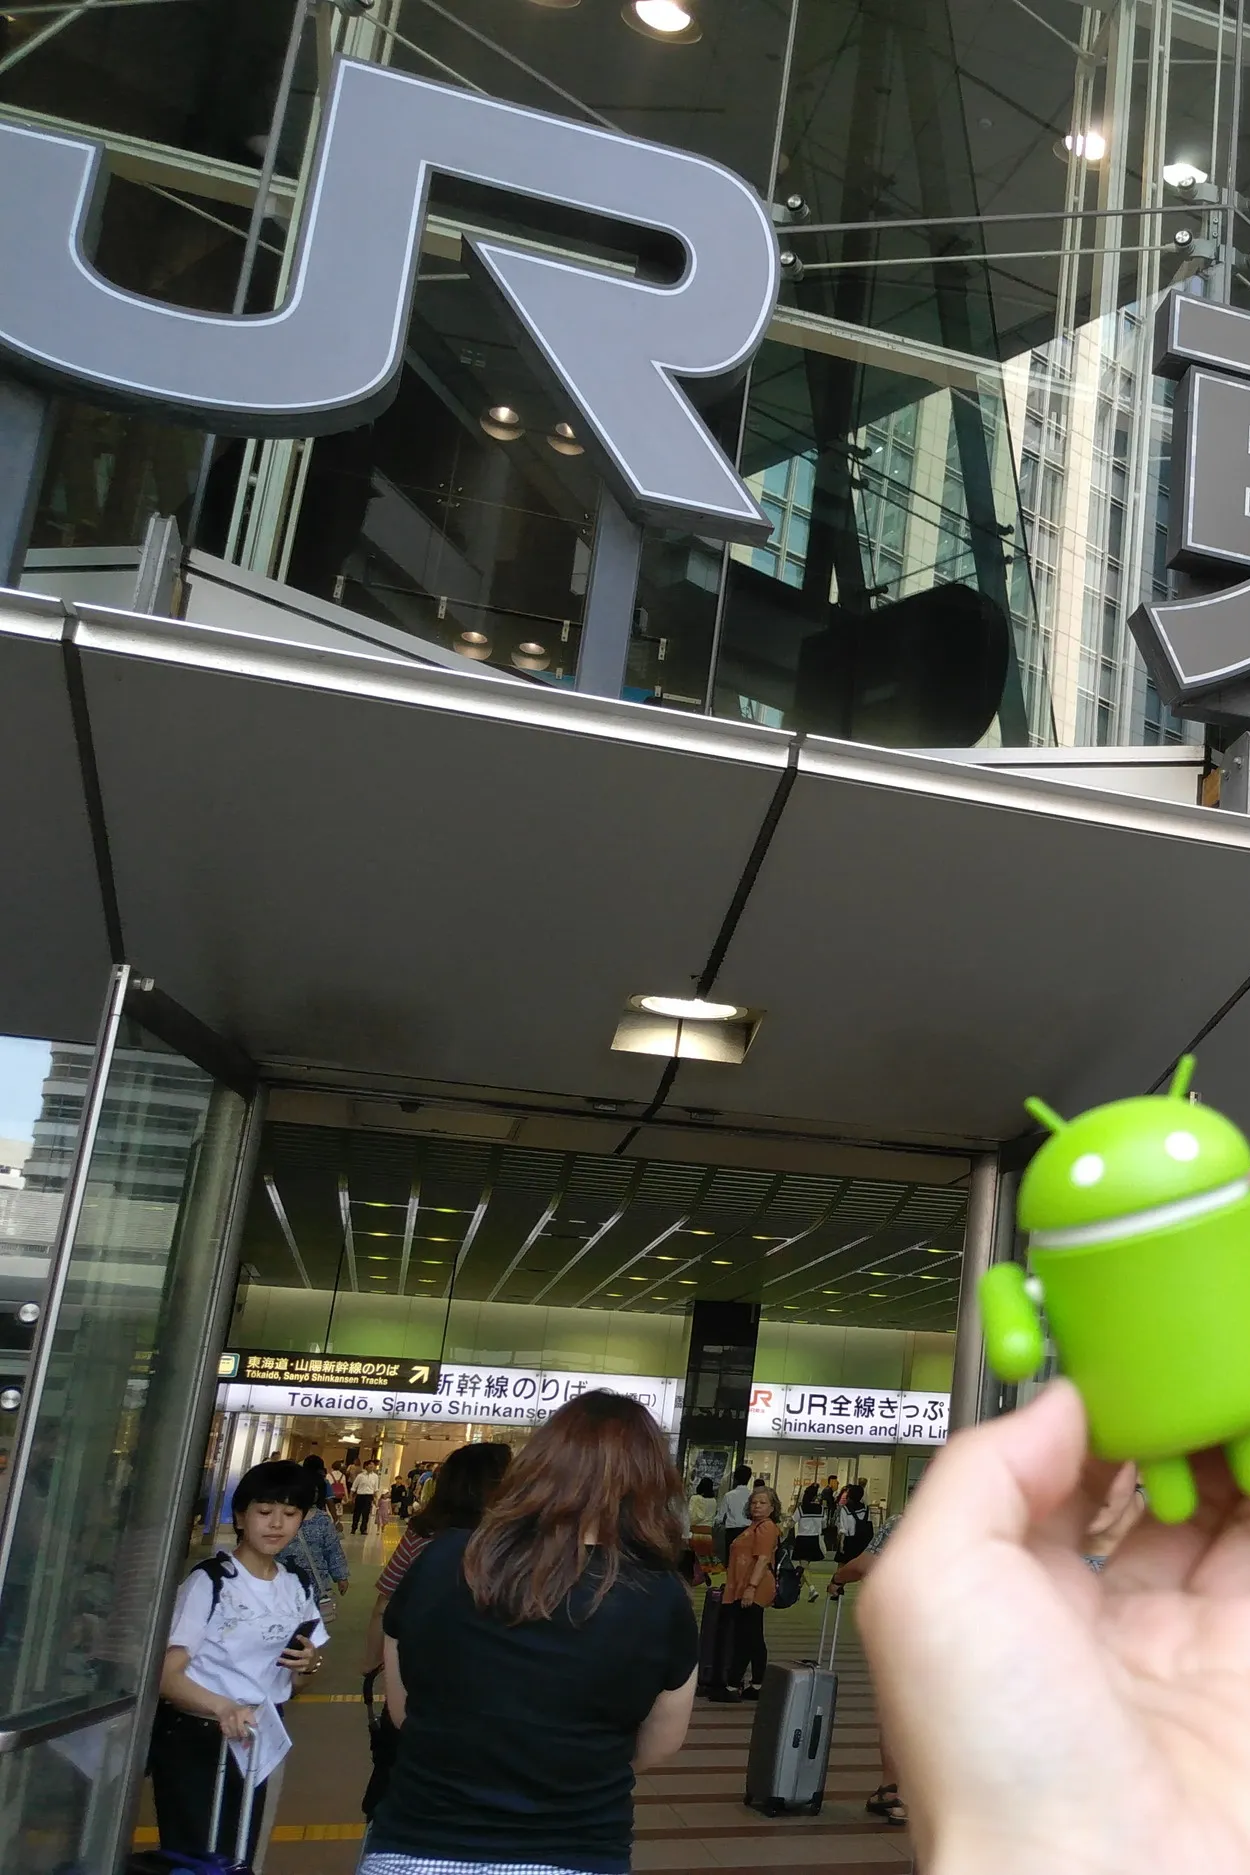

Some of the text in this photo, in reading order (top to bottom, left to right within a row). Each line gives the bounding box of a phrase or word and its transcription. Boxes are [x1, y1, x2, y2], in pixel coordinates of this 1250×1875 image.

[247, 1356, 400, 1377] 東海道・山陽新幹線のりば
[312, 1373, 359, 1384] Shinkansen
[361, 1376, 388, 1386] Tracks
[288, 1392, 374, 1412] Tōkaidō,
[382, 1396, 443, 1417] Sanyō
[786, 1393, 950, 1421] JR全線きっぷ
[771, 1417, 863, 1435] Shinkansen
[869, 1422, 897, 1437] and
[903, 1424, 923, 1438] JR
